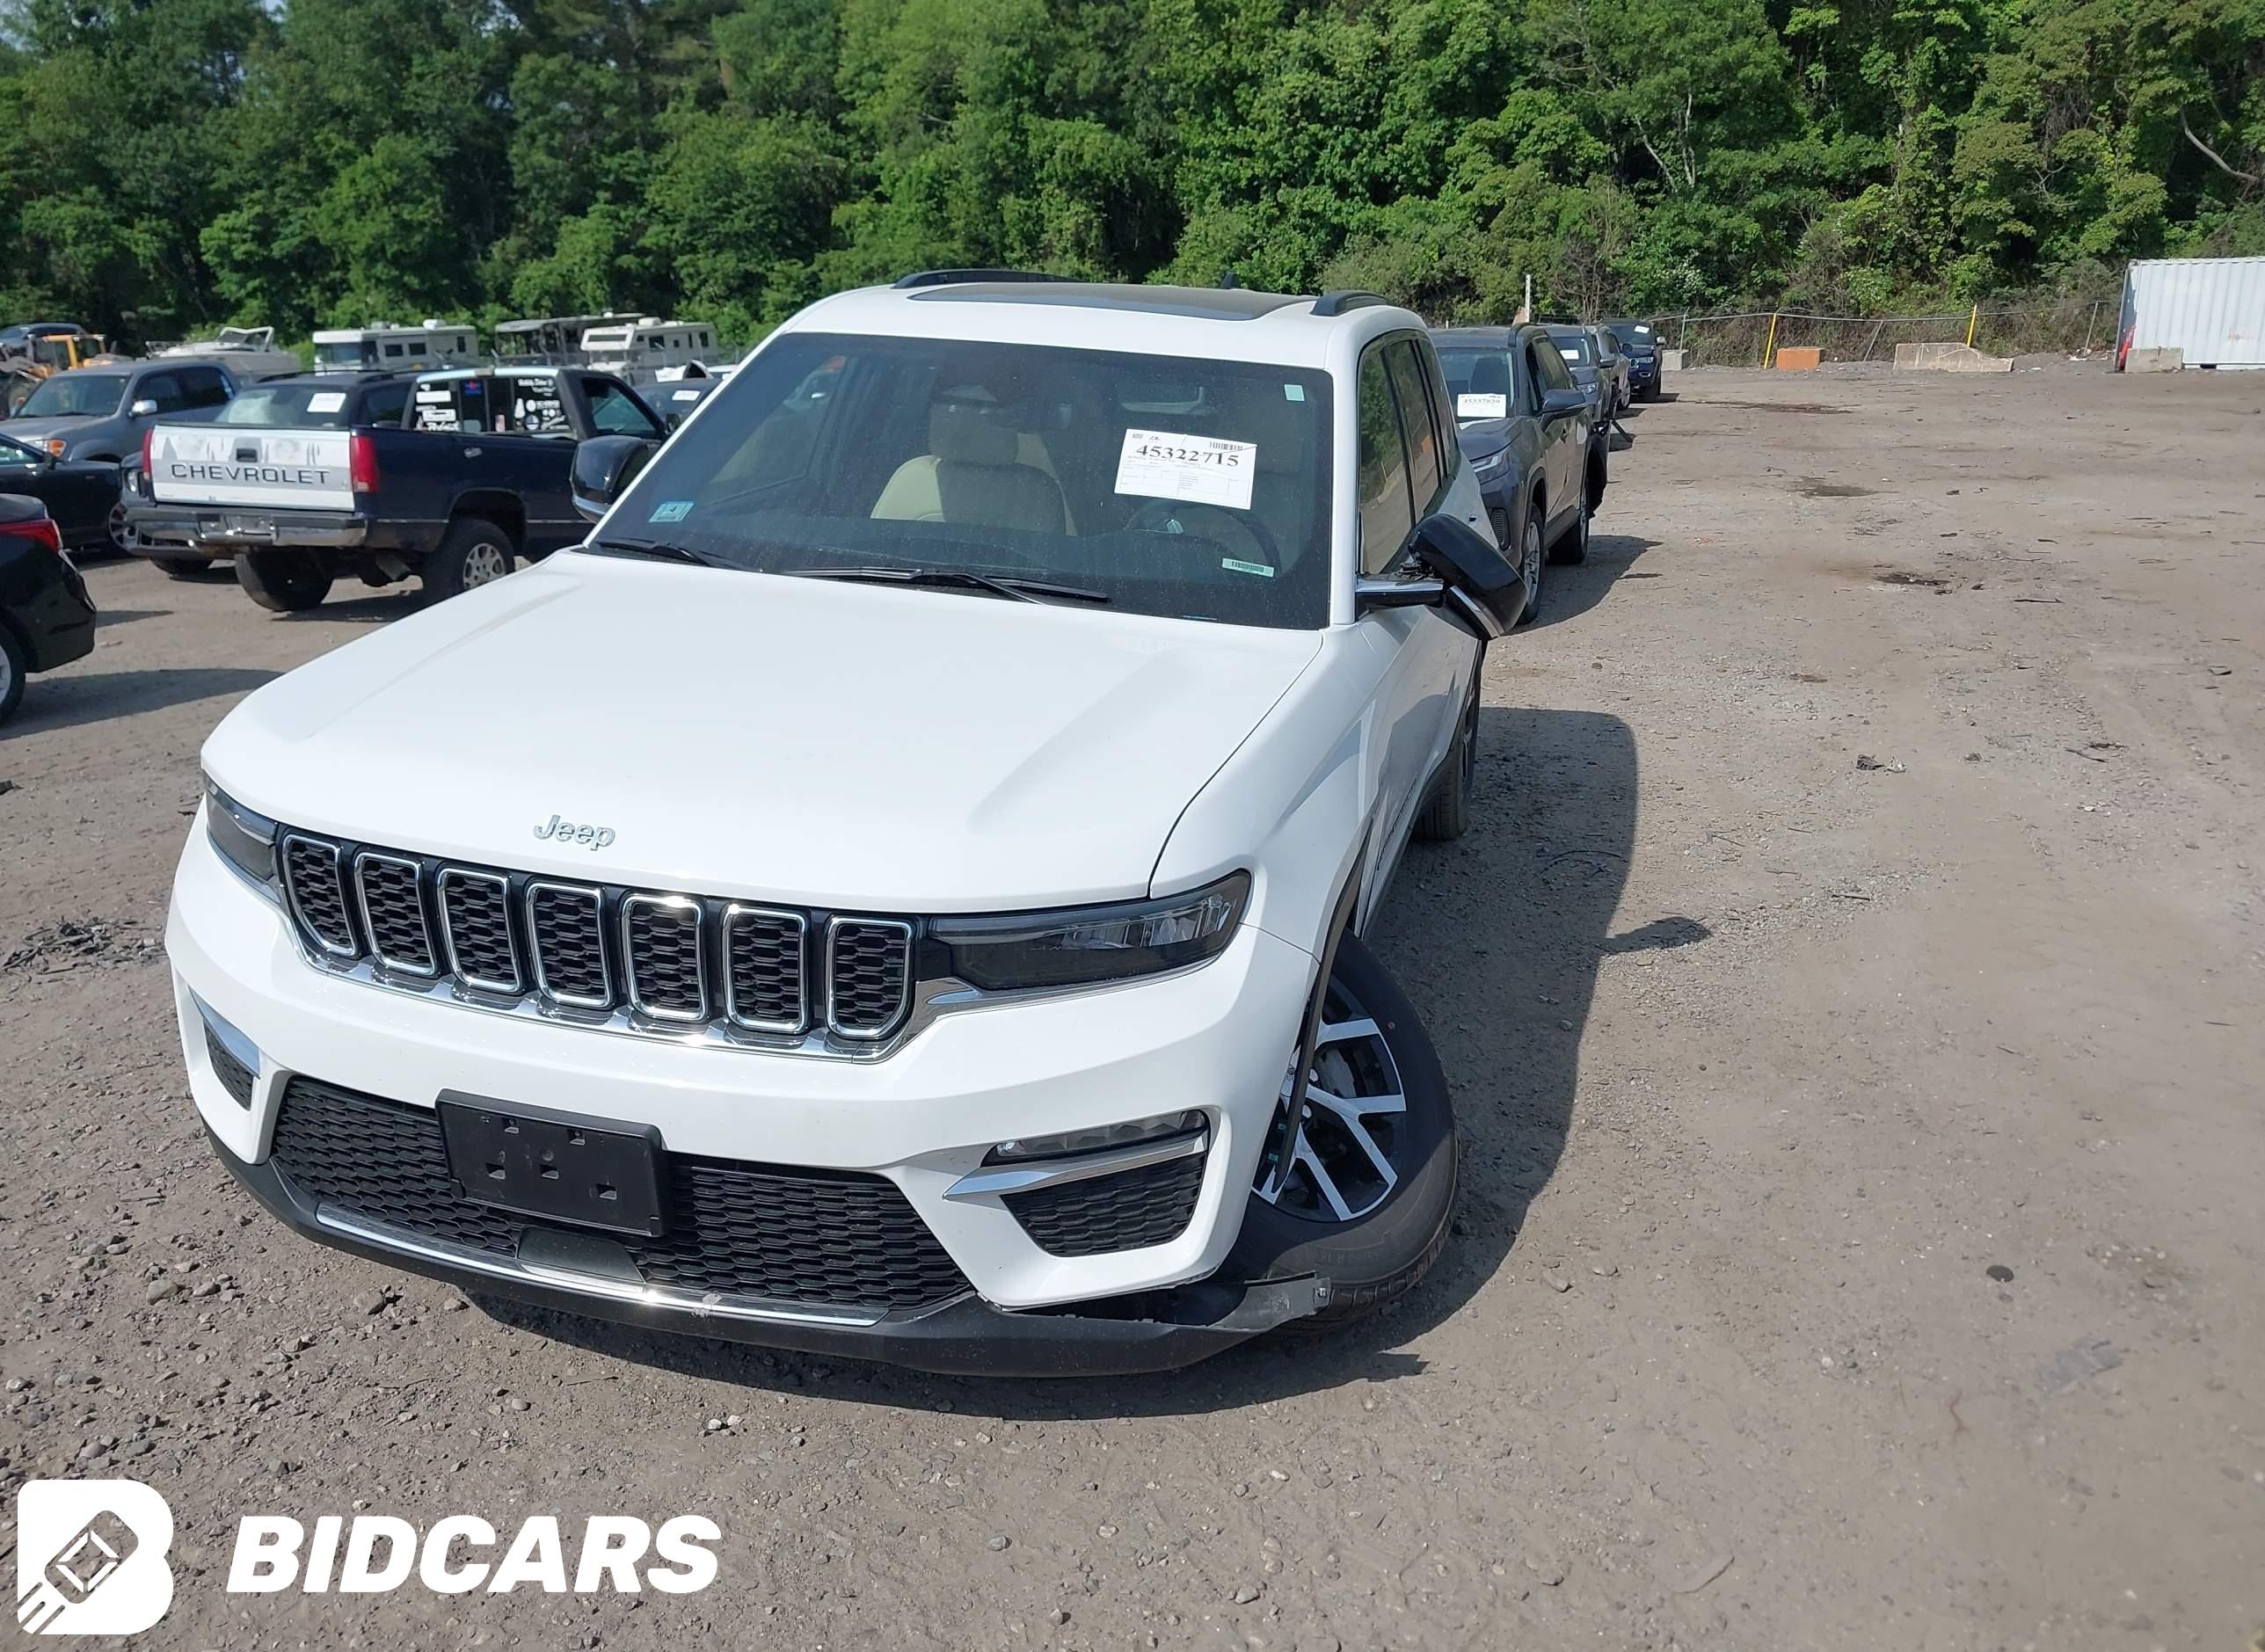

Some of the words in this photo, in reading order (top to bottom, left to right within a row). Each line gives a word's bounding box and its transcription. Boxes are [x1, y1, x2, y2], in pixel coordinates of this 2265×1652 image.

[1136, 444, 1239, 467] 45322715
[171, 463, 331, 484] CHEVROLET
[533, 814, 616, 852] Jeep
